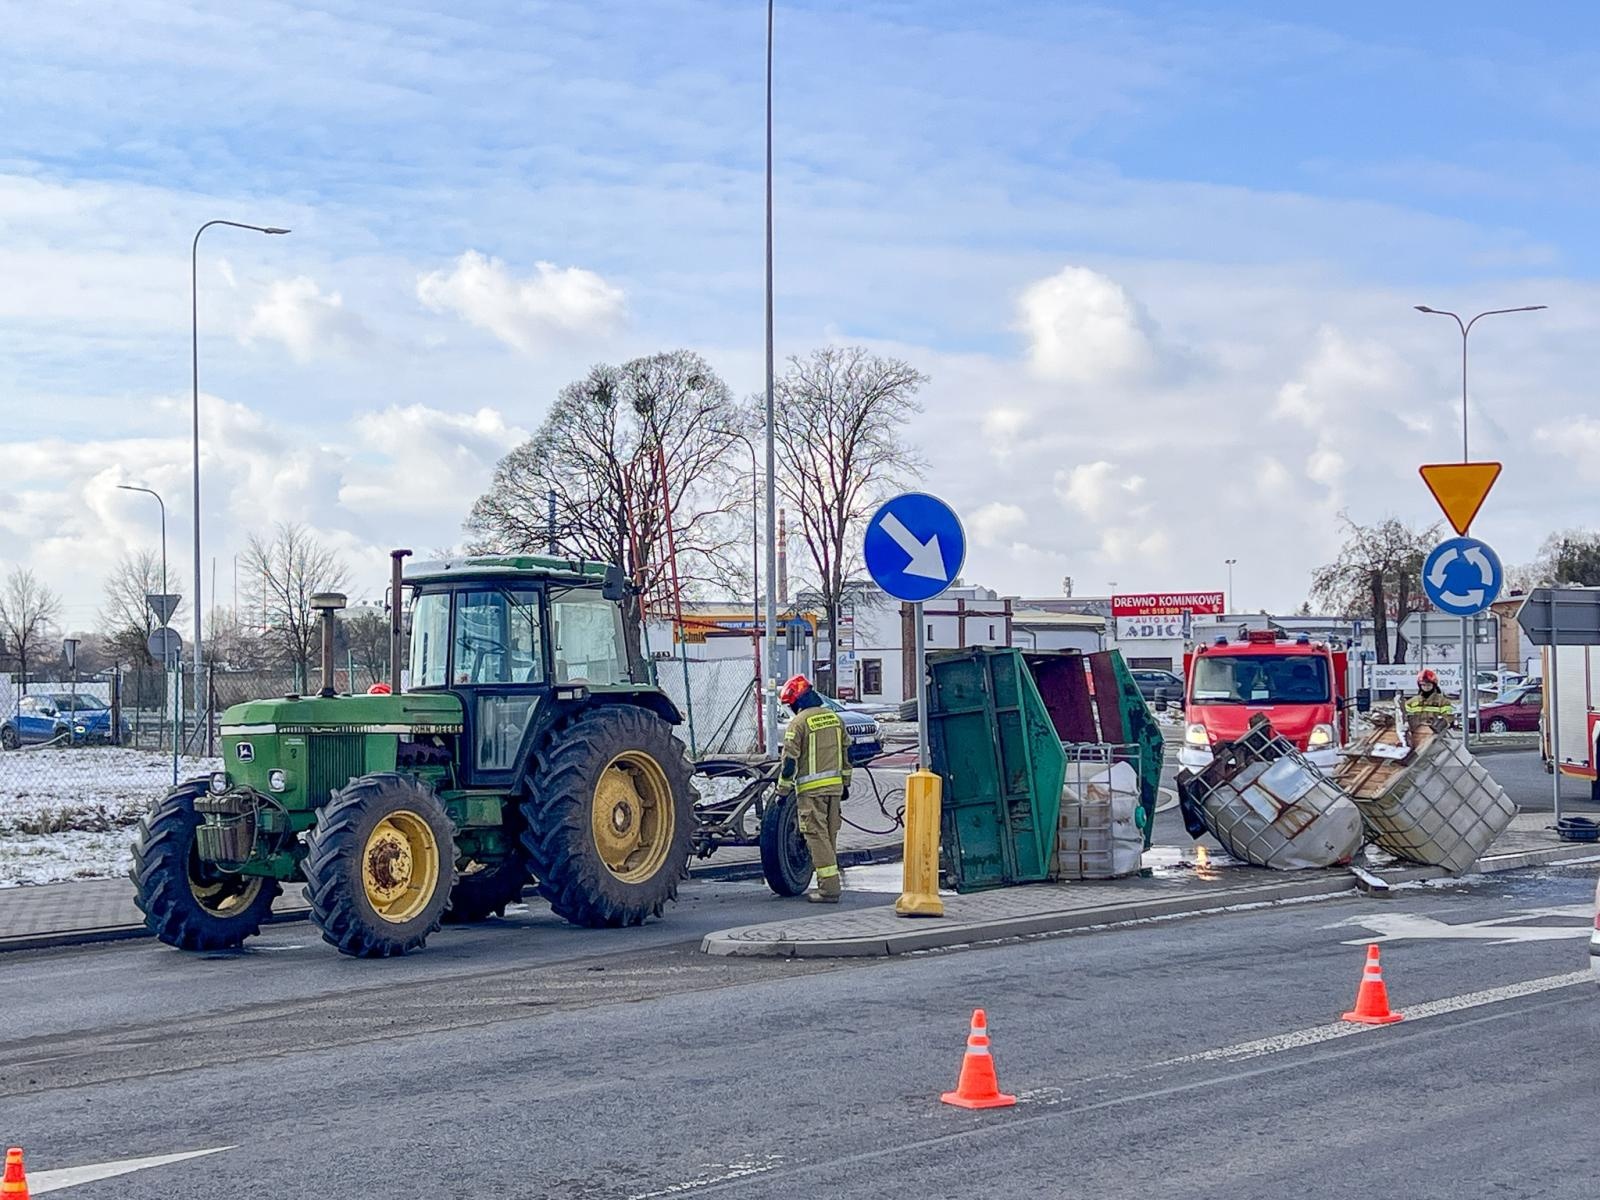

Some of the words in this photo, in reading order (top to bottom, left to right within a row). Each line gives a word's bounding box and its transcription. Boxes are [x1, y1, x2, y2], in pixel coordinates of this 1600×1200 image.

[1114, 596, 1156, 607] DREWNO
[1159, 594, 1222, 606] KOMINKOWE
[1135, 616, 1160, 624] AUTO
[410, 725, 431, 734] JOHN
[435, 725, 464, 734] DEERE
